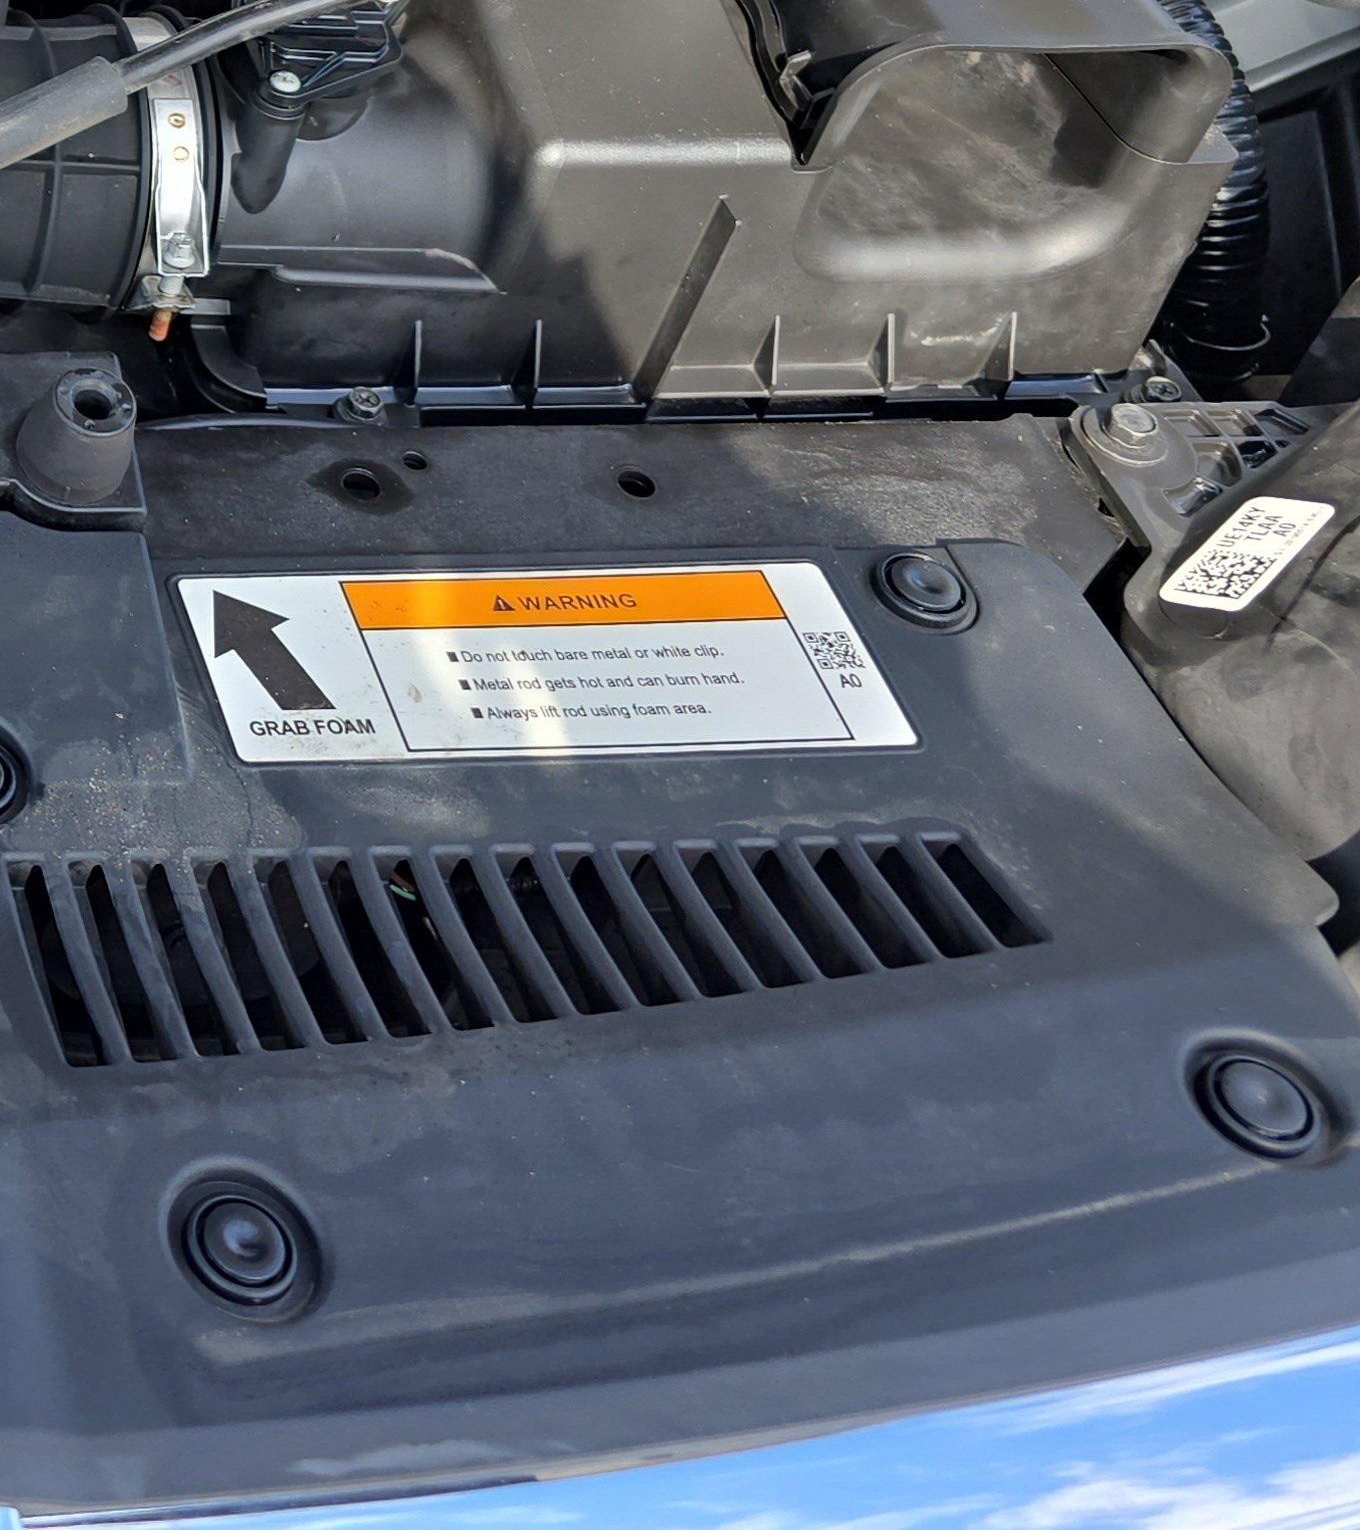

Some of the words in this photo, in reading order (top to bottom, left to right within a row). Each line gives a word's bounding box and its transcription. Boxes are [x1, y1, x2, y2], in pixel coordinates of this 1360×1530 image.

[1217, 506, 1266, 548] UE14KY
[1244, 514, 1284, 542] TLAA
[517, 593, 638, 612] WARNING
[461, 650, 482, 663] Do
[486, 649, 508, 662] not
[512, 648, 552, 662] touch
[555, 647, 588, 661] bare
[592, 645, 632, 661] metal
[636, 648, 649, 659] or
[652, 644, 690, 659] white
[694, 643, 724, 660] clip.
[473, 677, 513, 691] Metal
[516, 676, 541, 690] rod
[545, 677, 575, 693] gets
[579, 675, 602, 689] hot
[606, 674, 633, 688] and
[637, 676, 664, 687] can
[668, 673, 700, 686] burn
[703, 671, 745, 685] hand.
[839, 673, 862, 689] A0
[487, 705, 537, 723] Always
[540, 704, 560, 718] lift
[563, 704, 587, 718] rod
[590, 704, 629, 719] using
[632, 702, 668, 715] foam
[673, 702, 711, 715] area.
[249, 719, 310, 736] GRAB
[314, 718, 376, 735] FOAM
